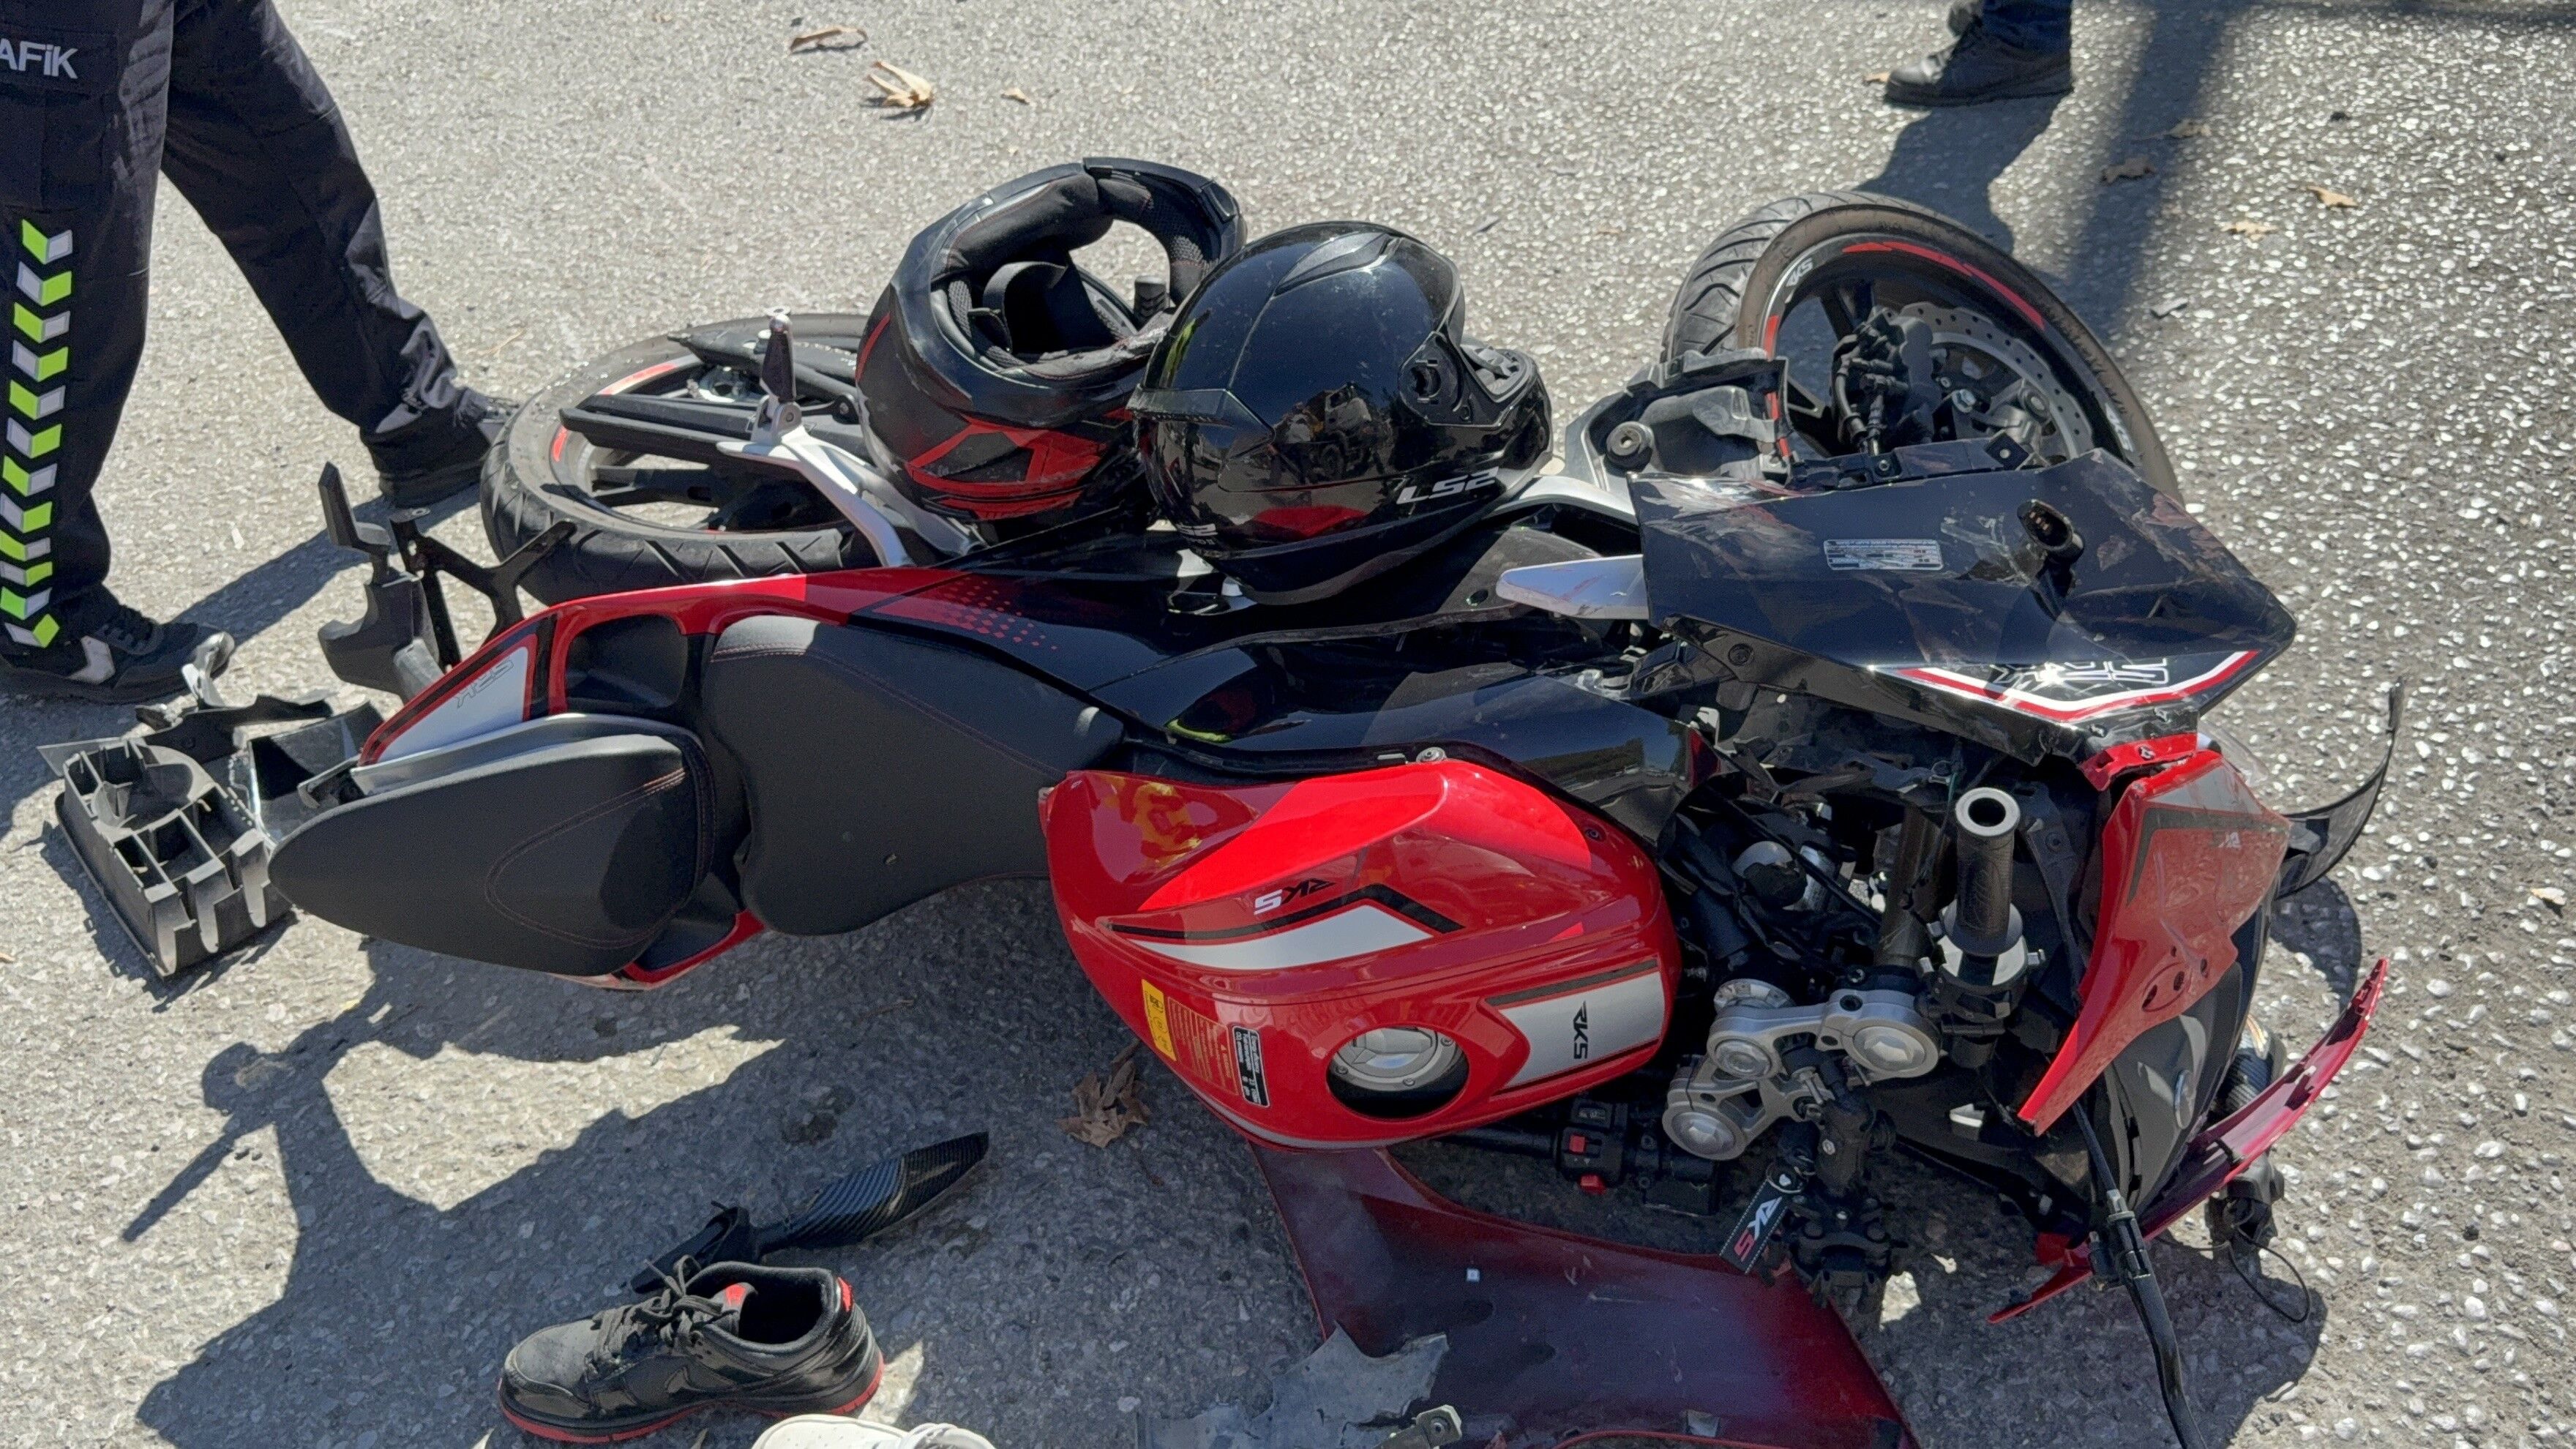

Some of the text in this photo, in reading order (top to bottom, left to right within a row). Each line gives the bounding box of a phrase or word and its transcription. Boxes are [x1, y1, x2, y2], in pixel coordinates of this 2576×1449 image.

[1396, 466, 1499, 504] LS2
[1254, 878, 1336, 916] RKS
[1573, 1000, 1589, 1060] RKS
[1734, 1196, 1783, 1262] RKS
